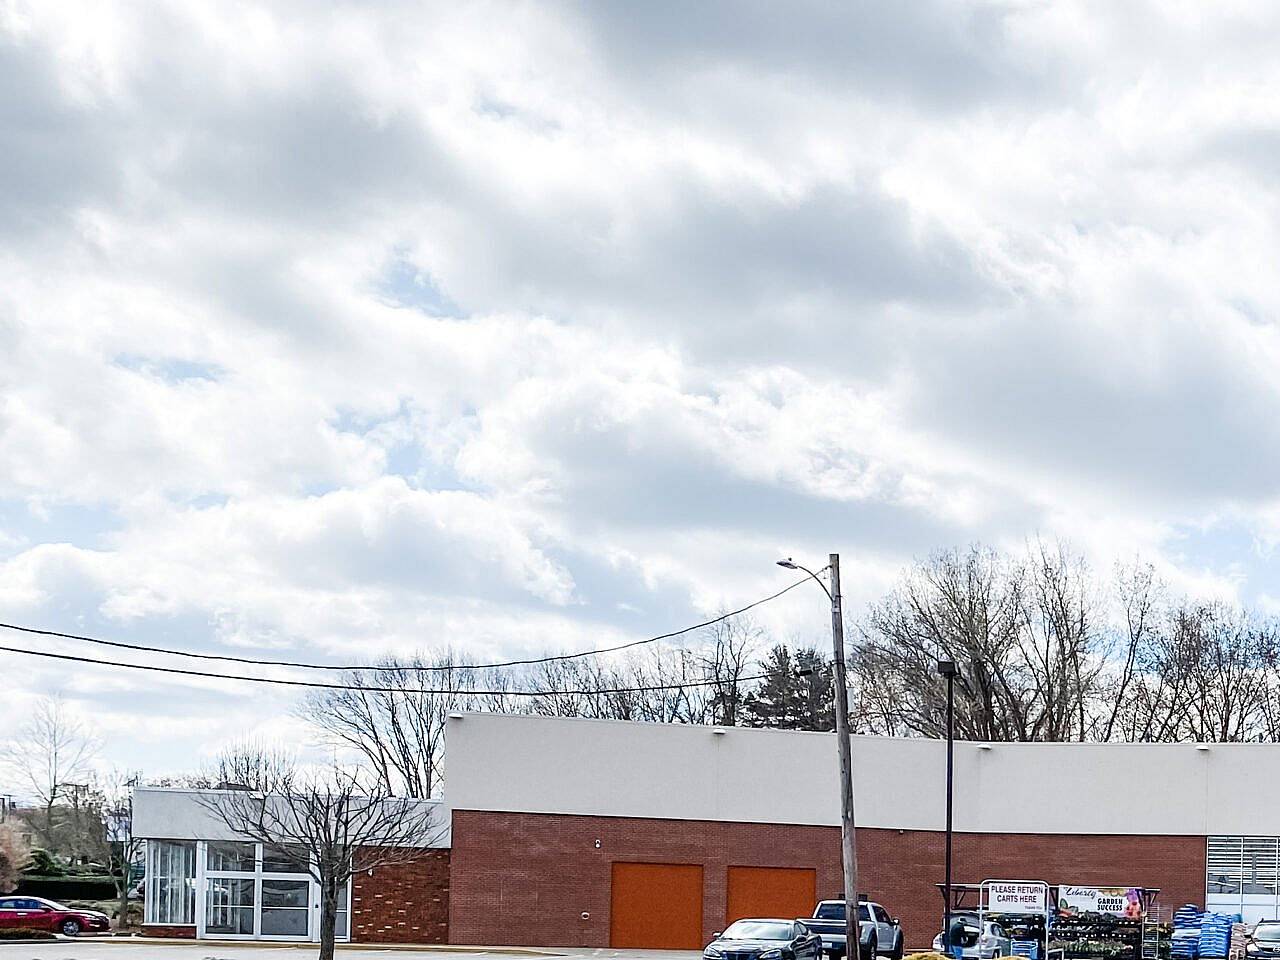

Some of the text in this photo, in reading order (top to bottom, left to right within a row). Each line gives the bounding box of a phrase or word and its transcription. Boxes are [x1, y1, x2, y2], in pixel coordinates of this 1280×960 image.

[991, 885, 1043, 894] PLEASE RETURN
[1066, 887, 1097, 900] Liberty
[996, 894, 1037, 903] CARTS HERE
